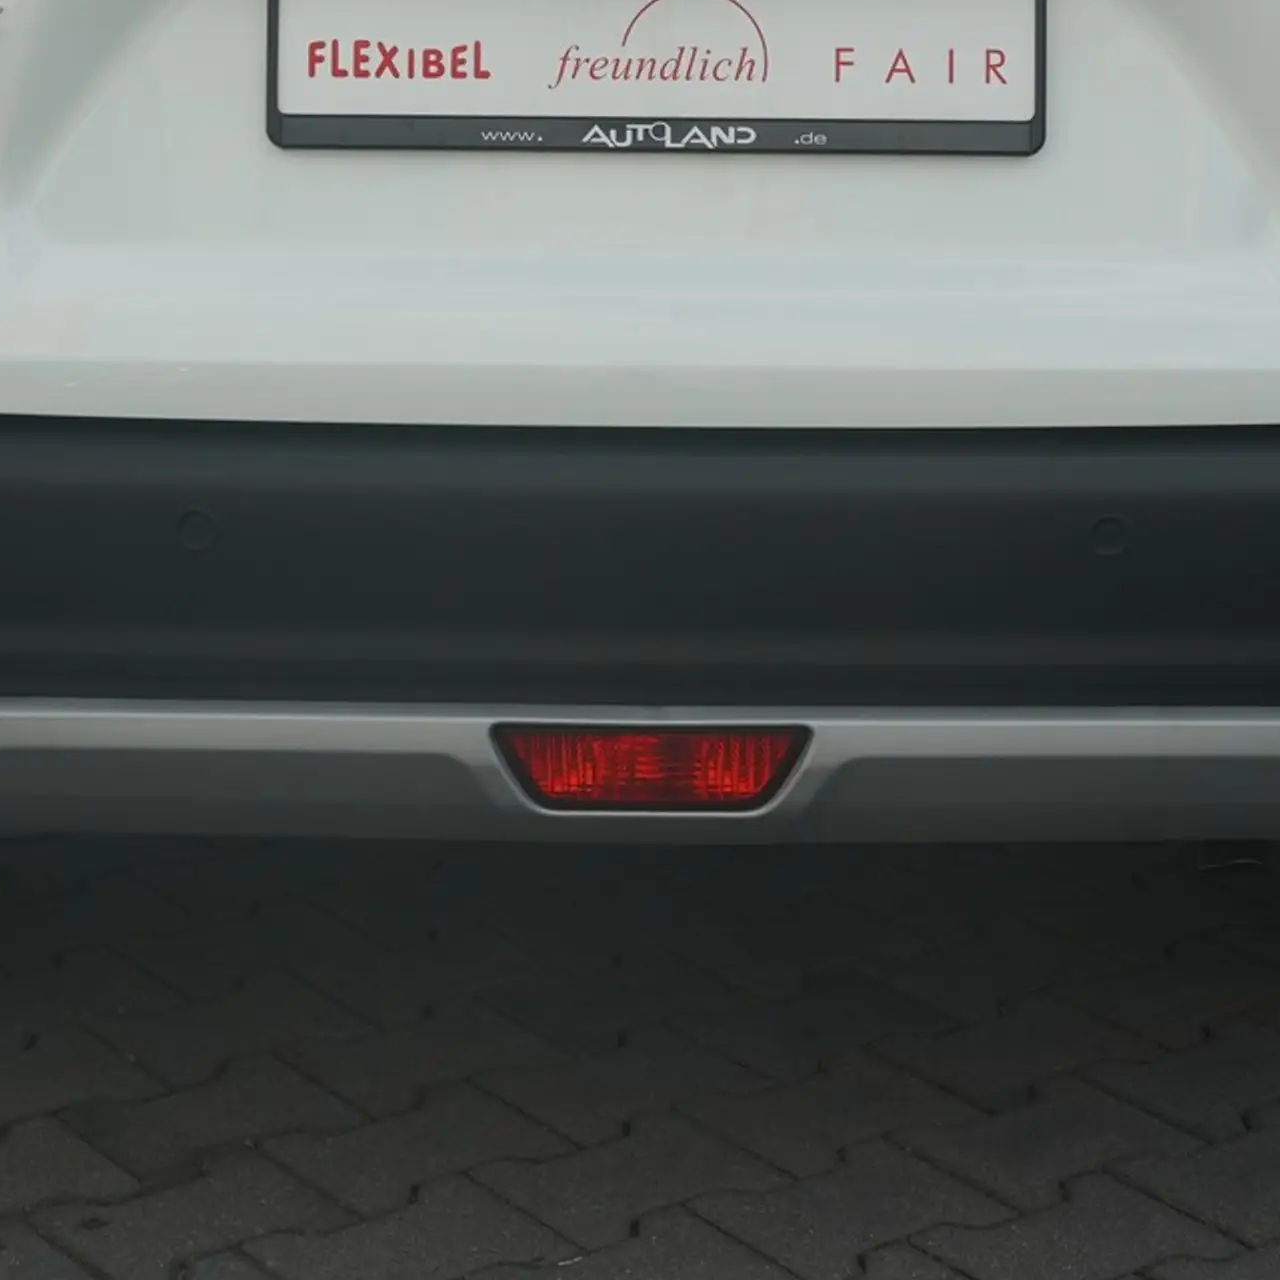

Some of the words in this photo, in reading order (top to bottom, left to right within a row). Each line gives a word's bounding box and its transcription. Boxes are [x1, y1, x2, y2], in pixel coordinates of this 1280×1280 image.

[307, 38, 491, 81] FLEXIBEL
[546, 44, 756, 90] freundlich
[833, 47, 1008, 85] FAIR
[481, 128, 543, 142] www.
[581, 121, 757, 150] AUTOLAND
[794, 129, 827, 146] .de
